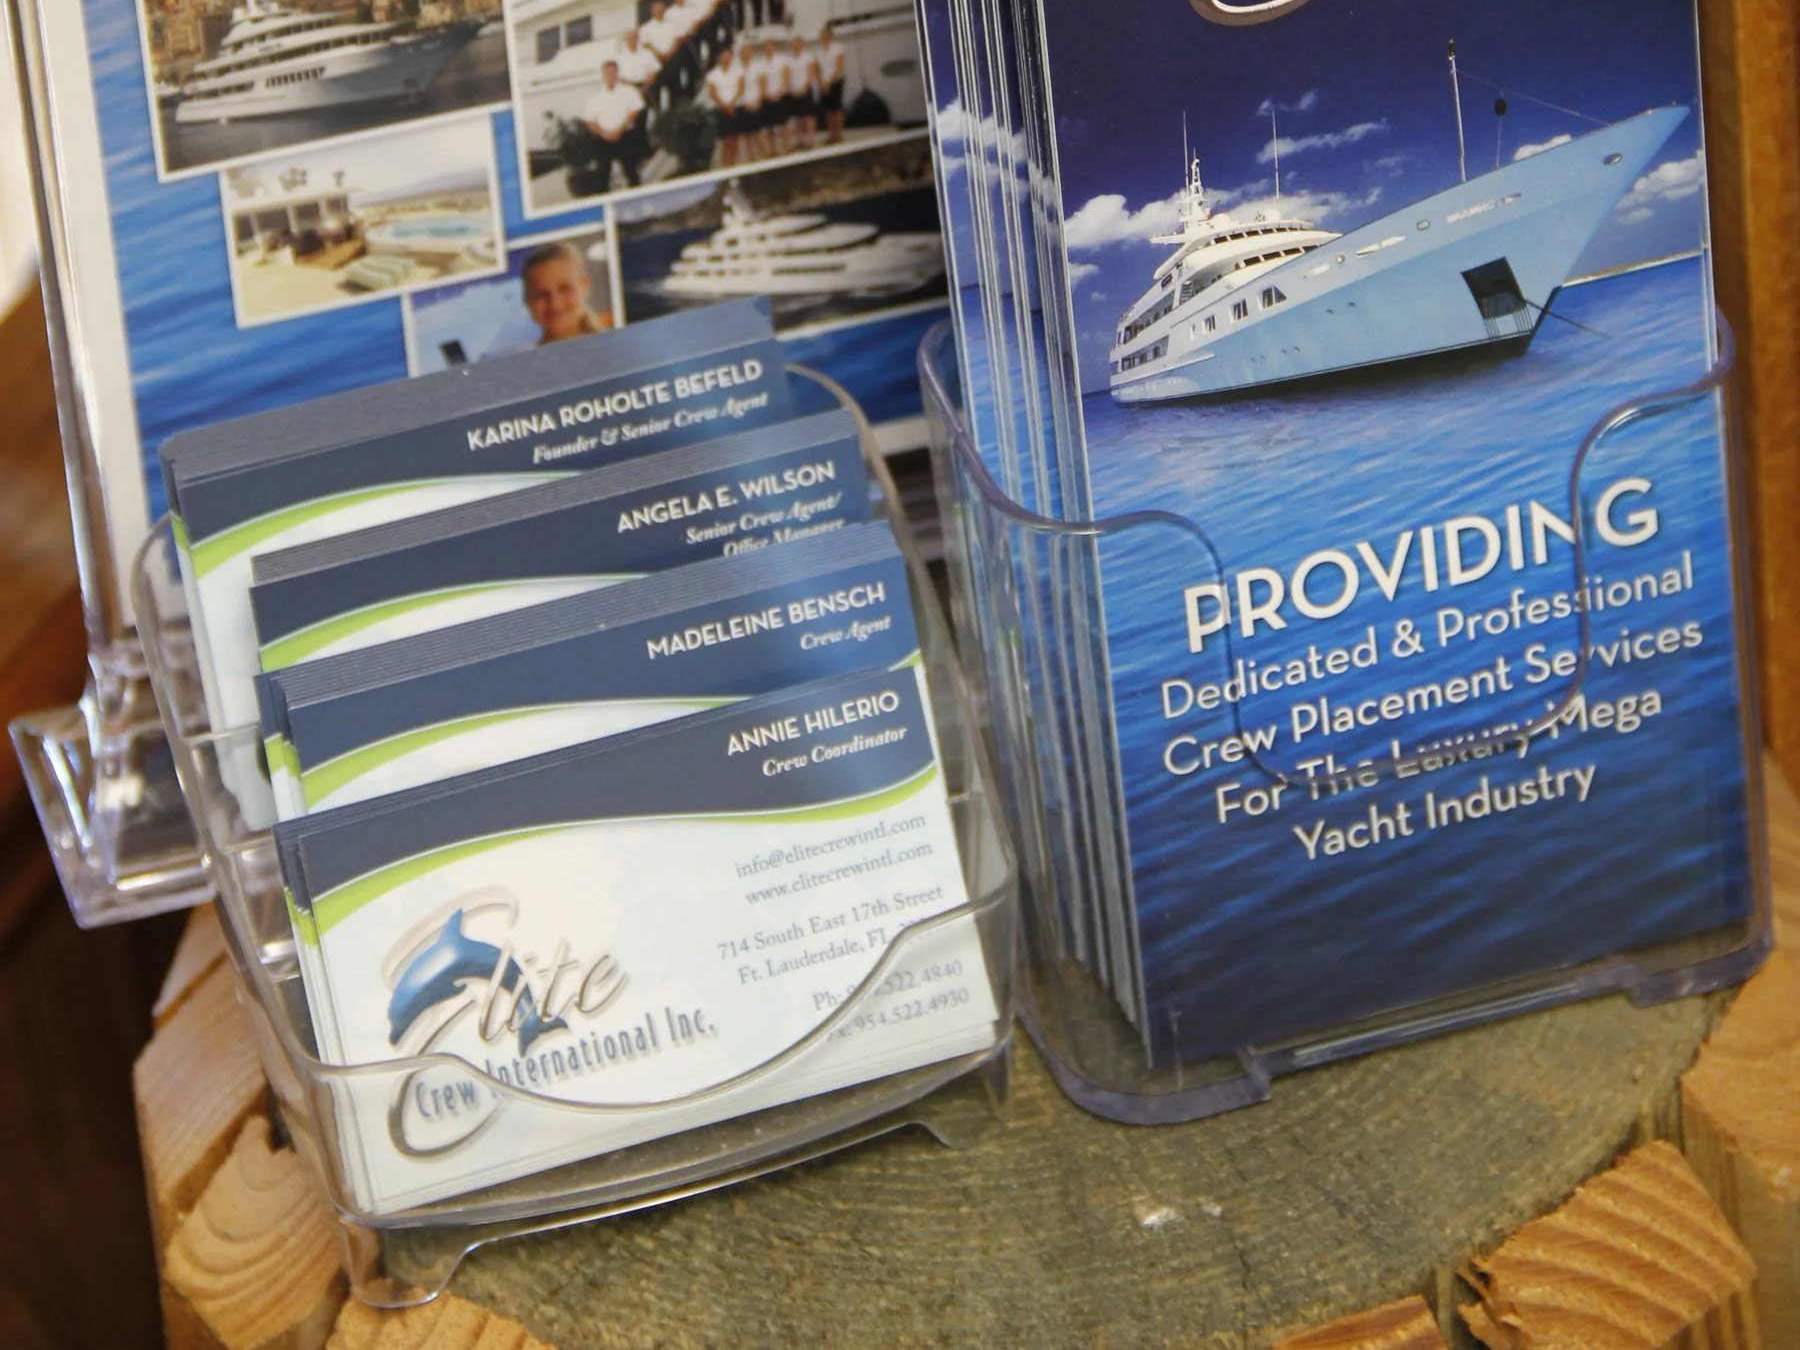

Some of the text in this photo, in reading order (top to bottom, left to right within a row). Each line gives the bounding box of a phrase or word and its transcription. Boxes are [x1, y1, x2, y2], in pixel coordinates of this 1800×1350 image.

[467, 359, 763, 451] KARINA ROHOLTE BEFELD
[532, 391, 768, 464] Founder & Senior Crew Agent
[617, 461, 835, 533] ANGELA E. WILSON
[686, 491, 842, 544] Senior Crew Agent/
[1183, 477, 1659, 653] PROVIDING
[647, 582, 886, 660] MADELEINE BENSCH
[800, 616, 891, 651] Crew Agent
[1161, 626, 1379, 719] Dedicated
[1392, 618, 1424, 656] &
[1163, 621, 1703, 776] Crew Placement Sevices
[727, 690, 899, 756] ANNIE HILERIO
[762, 725, 908, 778] Crew Coordinator
[1216, 772, 1286, 824] For
[1547, 687, 1662, 740] Mega
[735, 814, 927, 878] info@elitecrewintl.com
[1293, 764, 1596, 860] Yacht Industry
[745, 842, 933, 905] www.elitecrewintl.com
[717, 885, 944, 961] 714 South East 17th Street
[738, 966, 762, 985] Ft.
[767, 938, 865, 977] Lauderdale,
[854, 987, 969, 1033] 954.522.4930
[415, 1006, 716, 1119] Crew International Inc.
